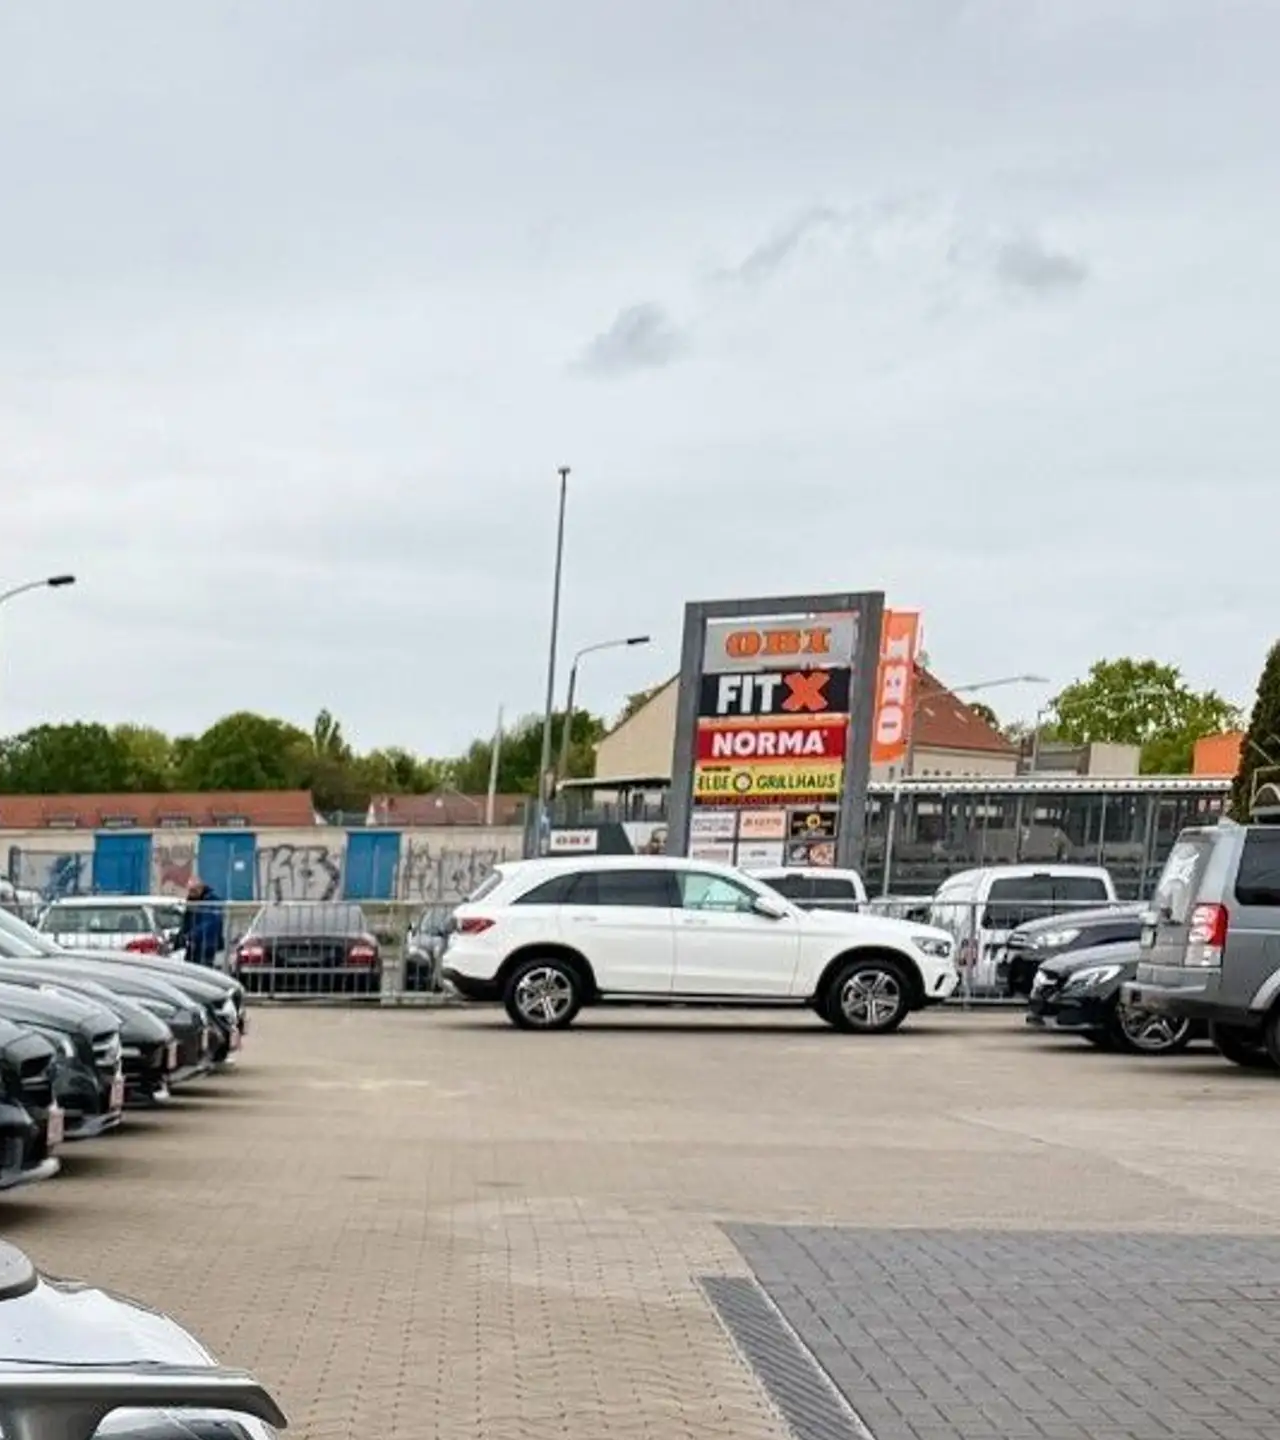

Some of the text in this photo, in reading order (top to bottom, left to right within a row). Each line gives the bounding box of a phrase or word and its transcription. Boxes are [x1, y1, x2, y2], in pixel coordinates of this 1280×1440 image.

[725, 627, 832, 658] OBI
[716, 671, 831, 715] FITX
[711, 728, 826, 757] NORMA
[756, 773, 836, 789] GRILLHAUS
